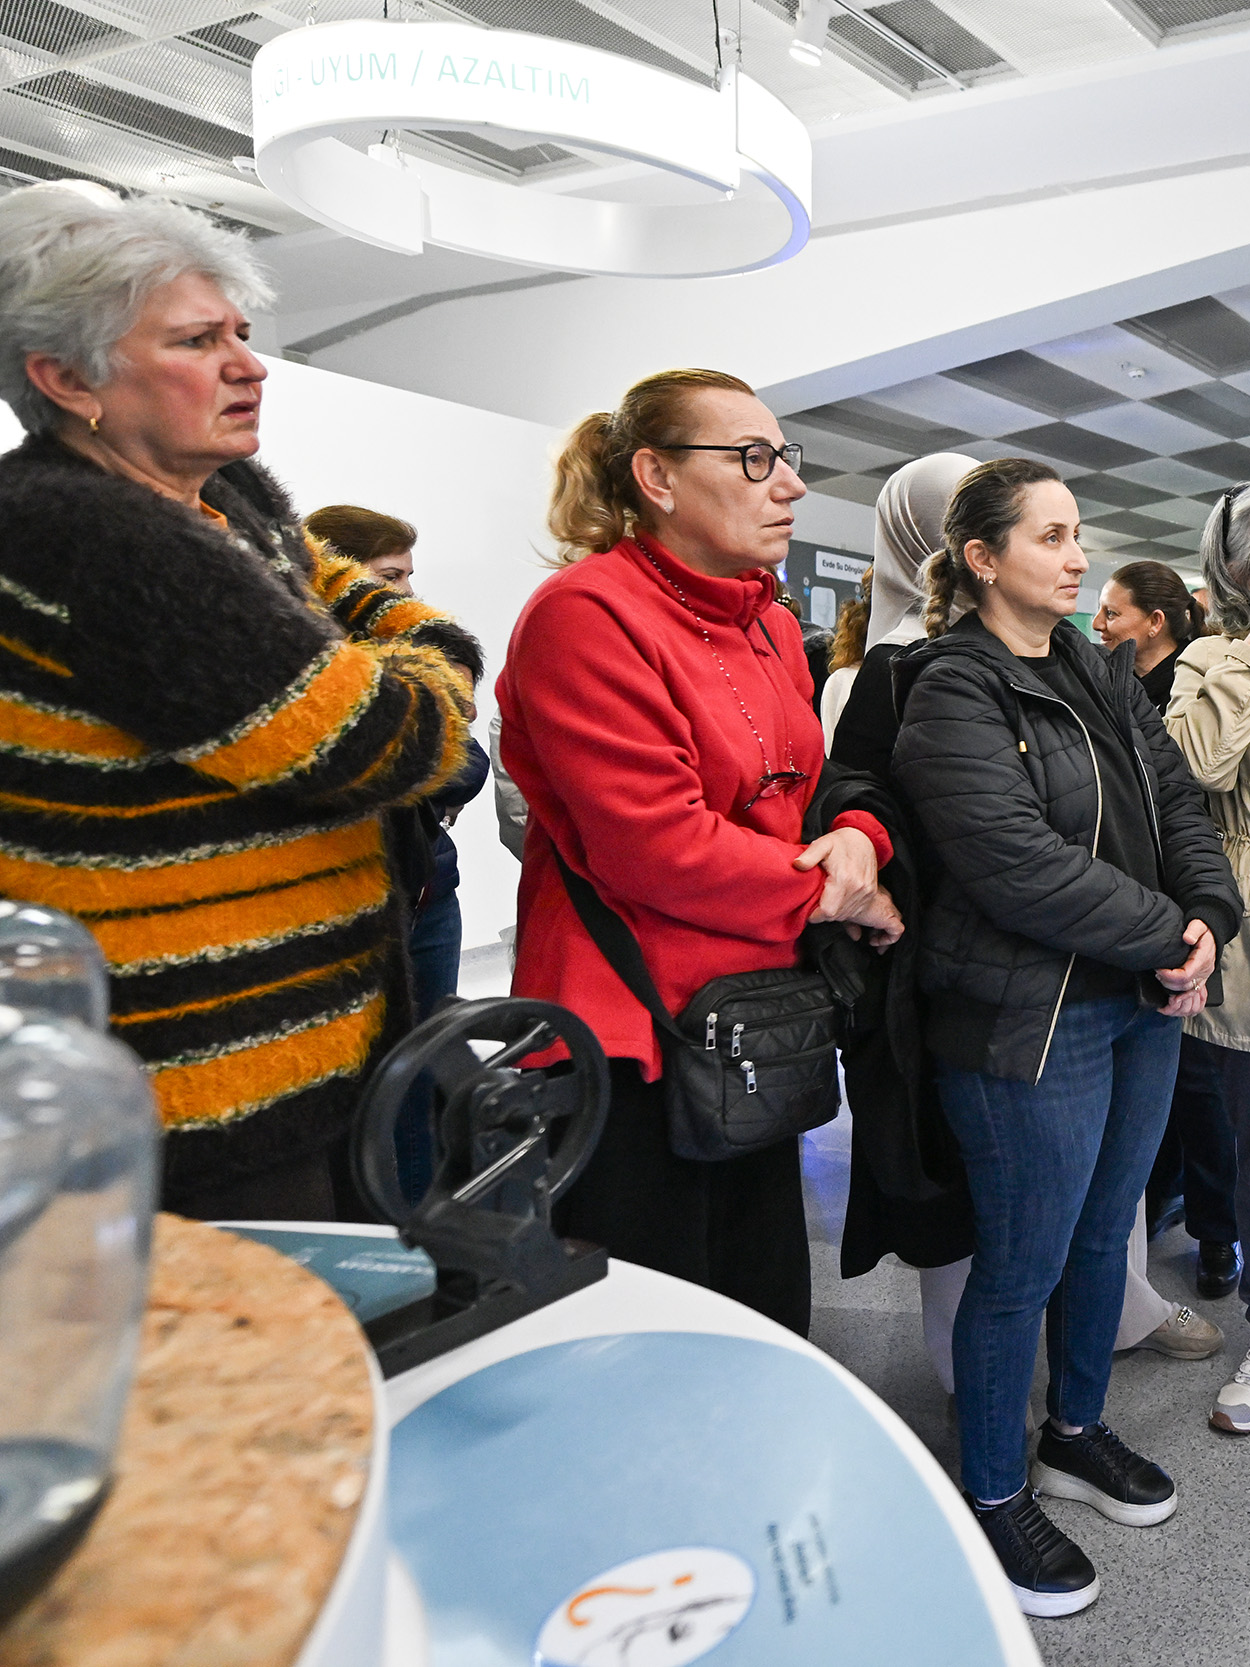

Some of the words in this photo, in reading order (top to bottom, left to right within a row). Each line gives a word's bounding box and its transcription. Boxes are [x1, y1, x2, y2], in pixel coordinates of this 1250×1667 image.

[311, 53, 396, 86] UYUM
[411, 50, 423, 86] /
[438, 55, 590, 104] AZALTIM
